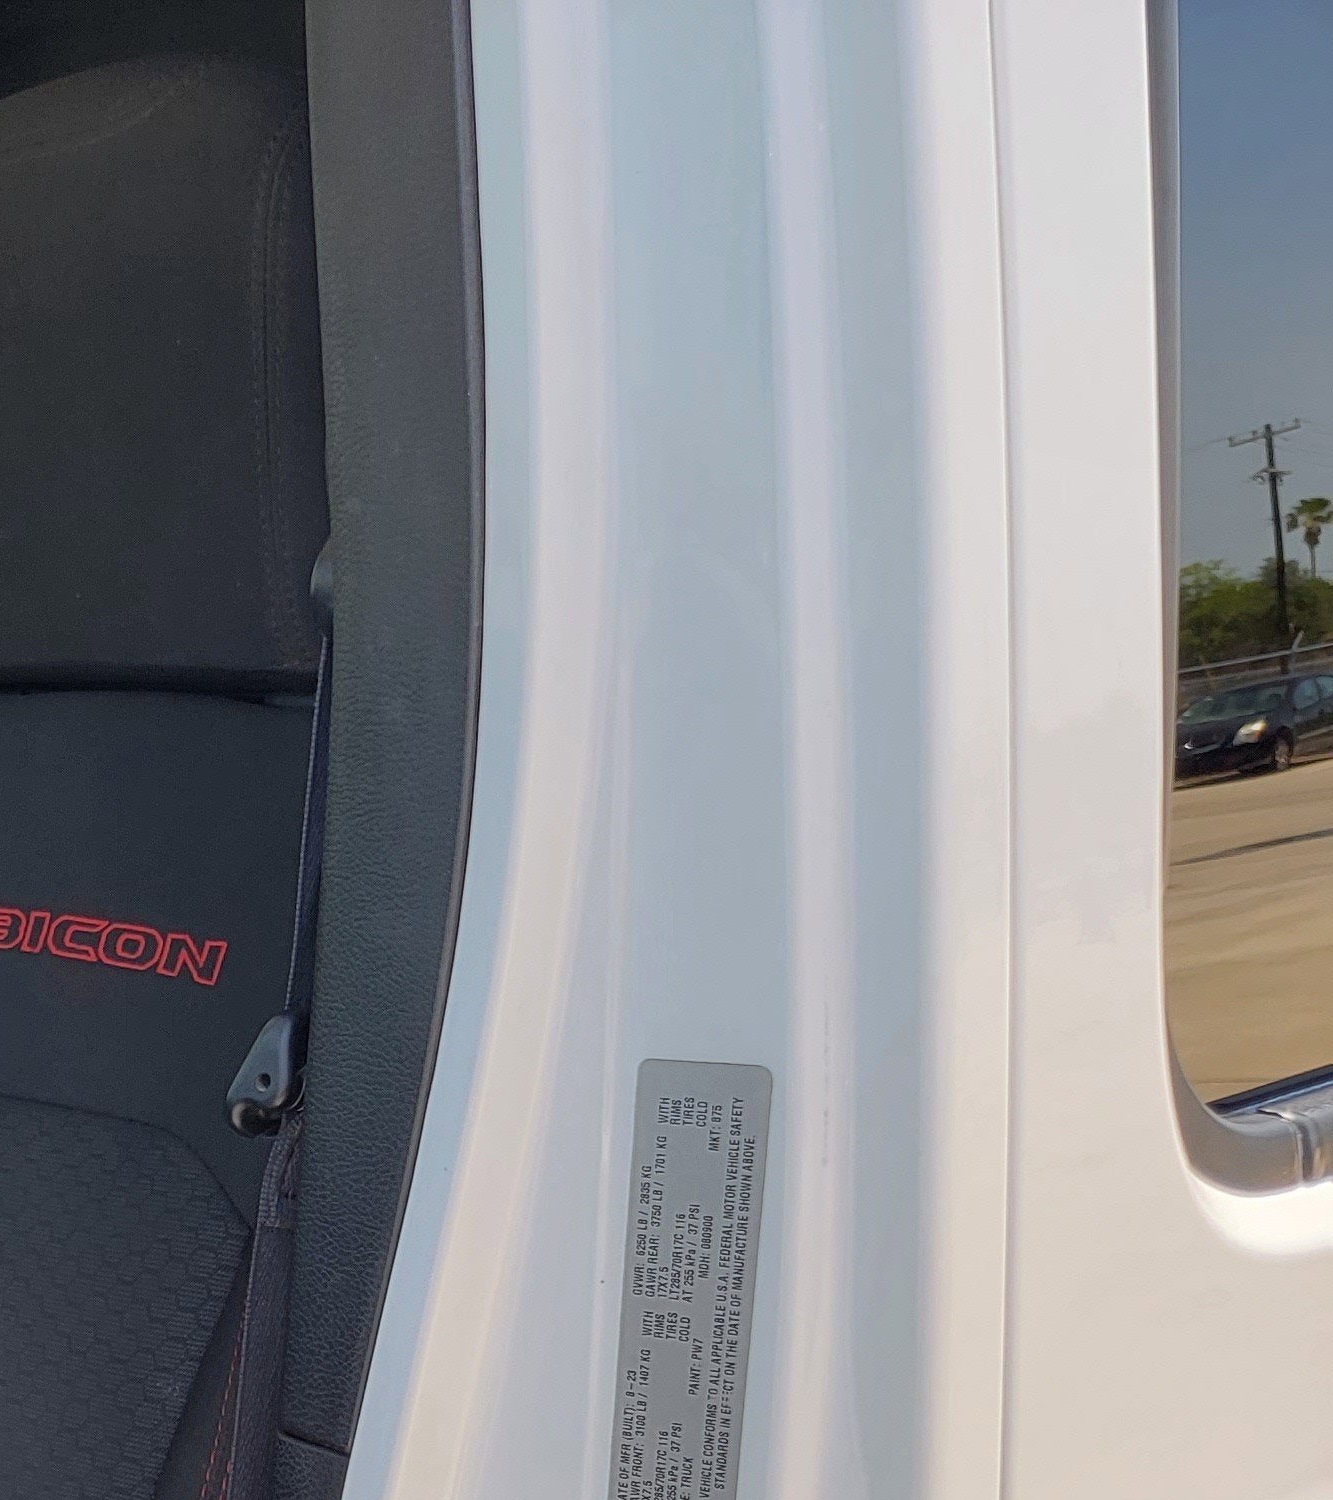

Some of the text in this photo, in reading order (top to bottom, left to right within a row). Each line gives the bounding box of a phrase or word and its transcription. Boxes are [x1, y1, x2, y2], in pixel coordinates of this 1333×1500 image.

[658, 1097, 671, 1124] WITH
[695, 1101, 708, 1128] COLD
[729, 1097, 744, 1137] SAFETY
[656, 1135, 668, 1149] KG
[708, 1126, 721, 1152] MKT:
[641, 1165, 652, 1179] KG
[654, 1153, 666, 1175] 1701
[674, 1213, 686, 1230] 116
[682, 1097, 695, 1126] TIRES
[725, 1139, 740, 1181] VEHICLE
[639, 1181, 651, 1205] 2835
[652, 1189, 663, 1202] LB
[657, 1099, 682, 1298] 17X7.5 RIMS
[722, 1184, 736, 1220] MOTOR
[737, 1174, 752, 1213] SHOWN
[637, 1218, 648, 1231] LB
[650, 1204, 662, 1228] 3750
[688, 1204, 700, 1220] PSI
[687, 1223, 699, 1235] 37
[635, 1233, 647, 1256] 6250
[647, 1233, 660, 1265] REAR:
[718, 1223, 733, 1269] FEDERAL
[731, 1215, 749, 1291] MANUFACTURE
[683, 1268, 695, 1287] 255
[698, 1252, 711, 1279] MDH:
[632, 1263, 645, 1296] GVWR:
[644, 1267, 657, 1298] GAWR
[715, 1271, 729, 1303] U.S.A.
[681, 1289, 693, 1303] AT
[729, 1293, 742, 1308] OF
[642, 1310, 654, 1337] WITH
[653, 1313, 665, 1339] RIMS
[678, 1316, 691, 1342] COLD
[710, 1305, 726, 1366] APPLICABLE
[727, 1309, 741, 1337] DATE
[640, 1348, 651, 1363] KG
[725, 1339, 738, 1360] THE
[638, 1364, 650, 1387] 1407
[657, 1430, 669, 1446] 116
[665, 1311, 678, 1341] TIRES
[688, 1337, 704, 1396] PAINT: PW7
[708, 1366, 721, 1386] ALL
[724, 1361, 736, 1377] ON
[636, 1400, 647, 1412] LB
[622, 1403, 636, 1441] (BUILT):
[634, 1414, 646, 1437] 3100
[670, 1422, 683, 1439] PSI
[702, 1403, 717, 1458] CONFORMS
[719, 1417, 731, 1429] IN
[620, 1443, 631, 1465] MFR
[669, 1440, 681, 1453] 37
[618, 1466, 630, 1480] OF
[631, 1442, 644, 1478] FRONT:
[680, 1456, 693, 1489] TRUCK
[714, 1431, 730, 1491] STANDARDS
[699, 1459, 713, 1500] VEHICLE
